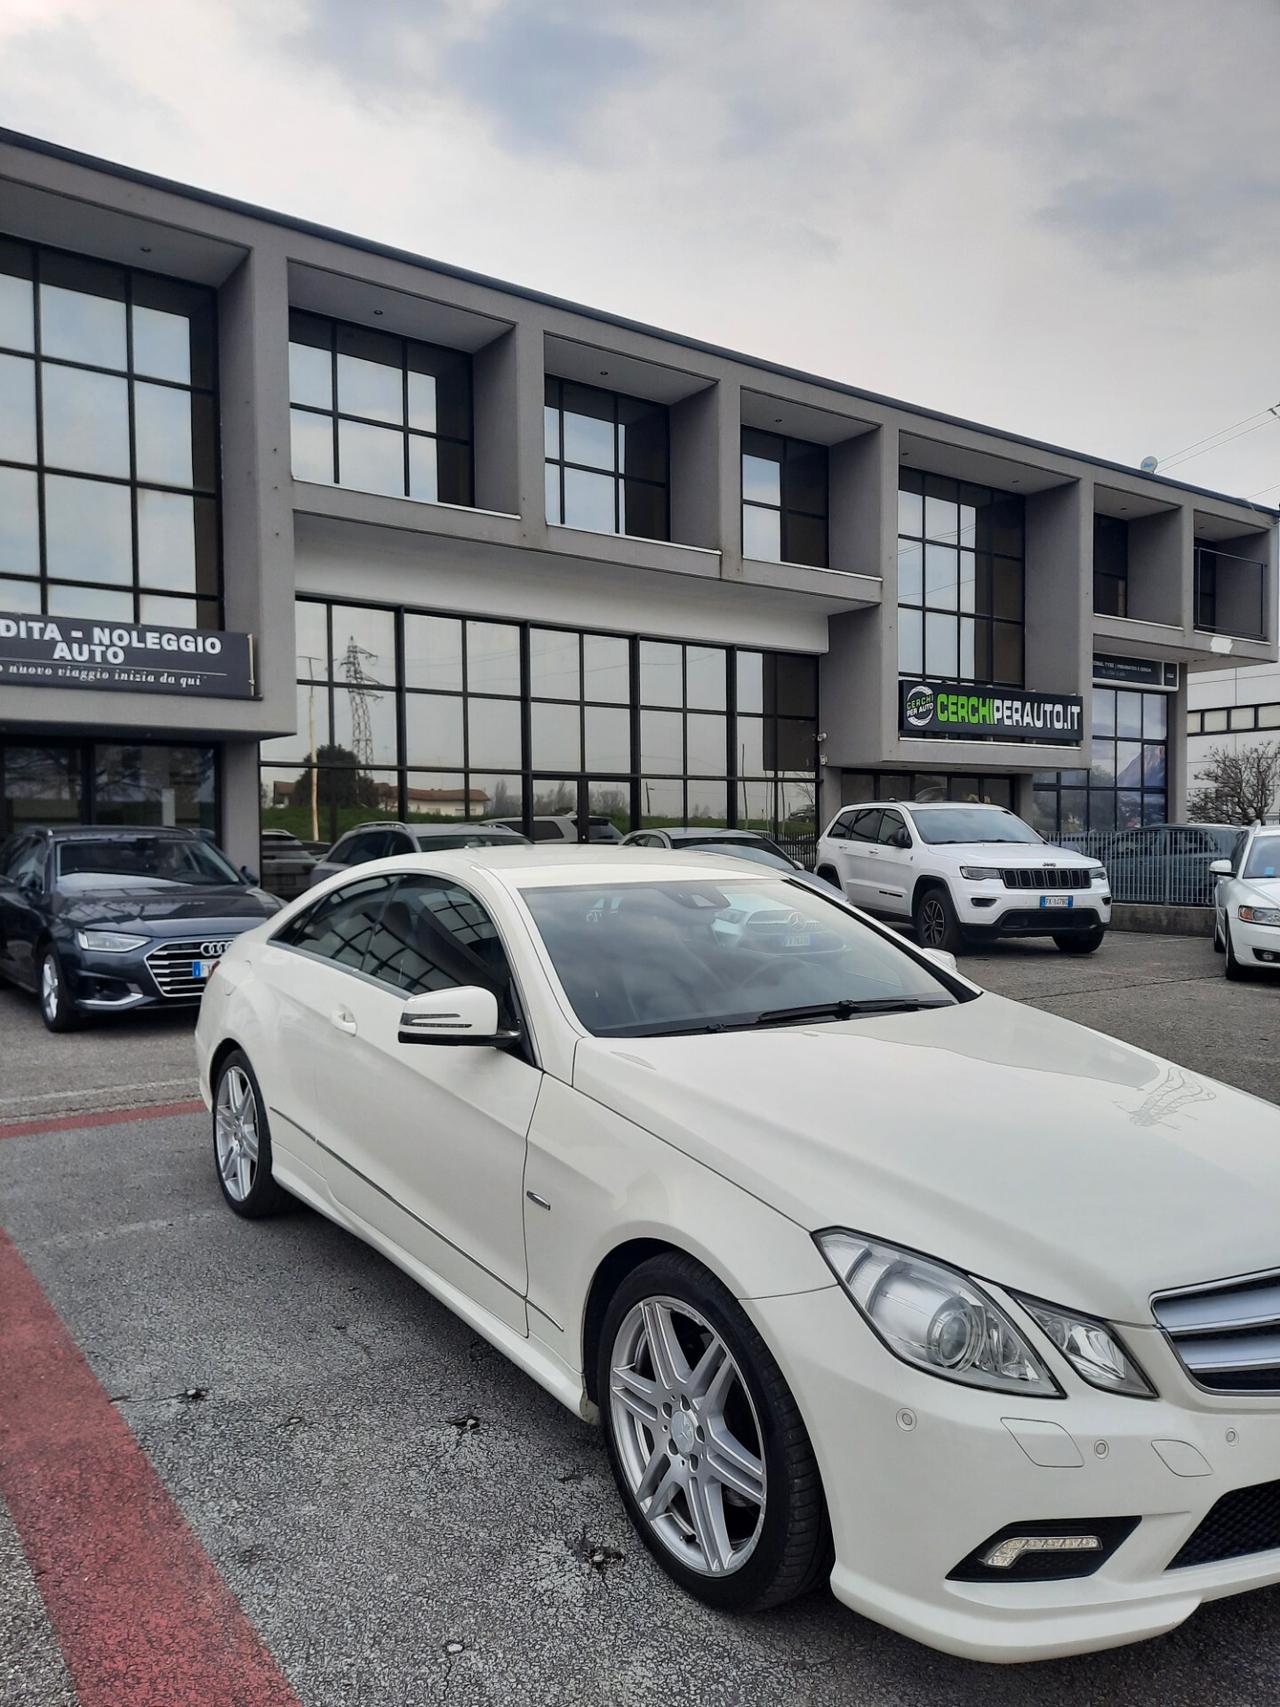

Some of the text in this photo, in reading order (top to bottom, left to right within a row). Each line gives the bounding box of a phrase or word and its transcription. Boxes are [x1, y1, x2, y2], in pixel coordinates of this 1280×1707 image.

[92, 626, 222, 654] NOLEGGIO
[53, 642, 125, 665] AUTO
[9, 664, 53, 676] nuovo
[58, 666, 110, 682] viaggio
[114, 669, 155, 683] inizia
[159, 672, 175, 684] da
[906, 702, 934, 718] PER AUTO
[937, 693, 1081, 730] CERCHIPERAUTO.IT
